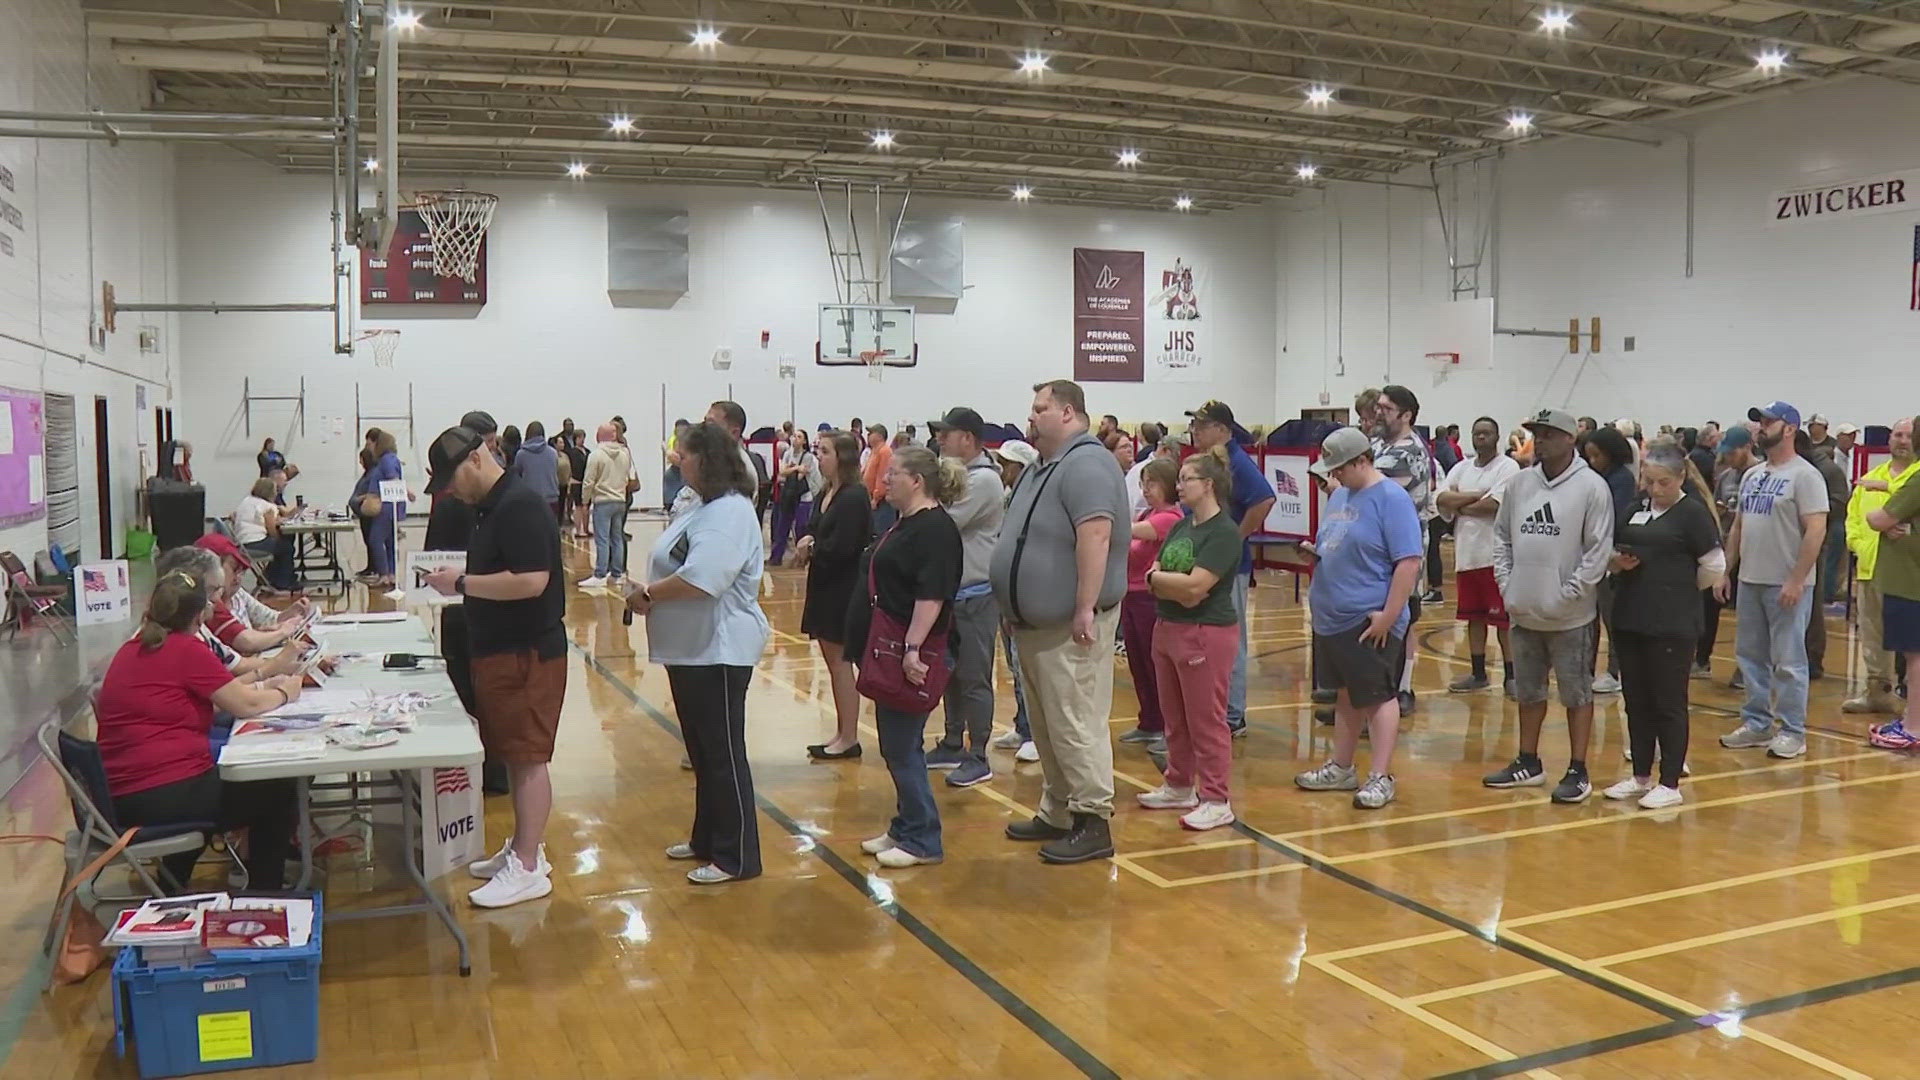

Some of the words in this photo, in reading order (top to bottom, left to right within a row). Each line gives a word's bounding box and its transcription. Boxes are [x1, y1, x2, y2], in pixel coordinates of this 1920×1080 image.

[1776, 179, 1906, 220] ZWICKER
[1086, 330, 1130, 340] PREPARED.
[1164, 330, 1194, 352] JHS
[1081, 342, 1136, 352] EMPOWERED.
[1088, 353, 1128, 363] INSPIRED.
[1280, 501, 1302, 514] VOTE
[1520, 522, 1561, 536] adidas
[87, 601, 112, 612] VOTE
[440, 815, 474, 843] VOTE
